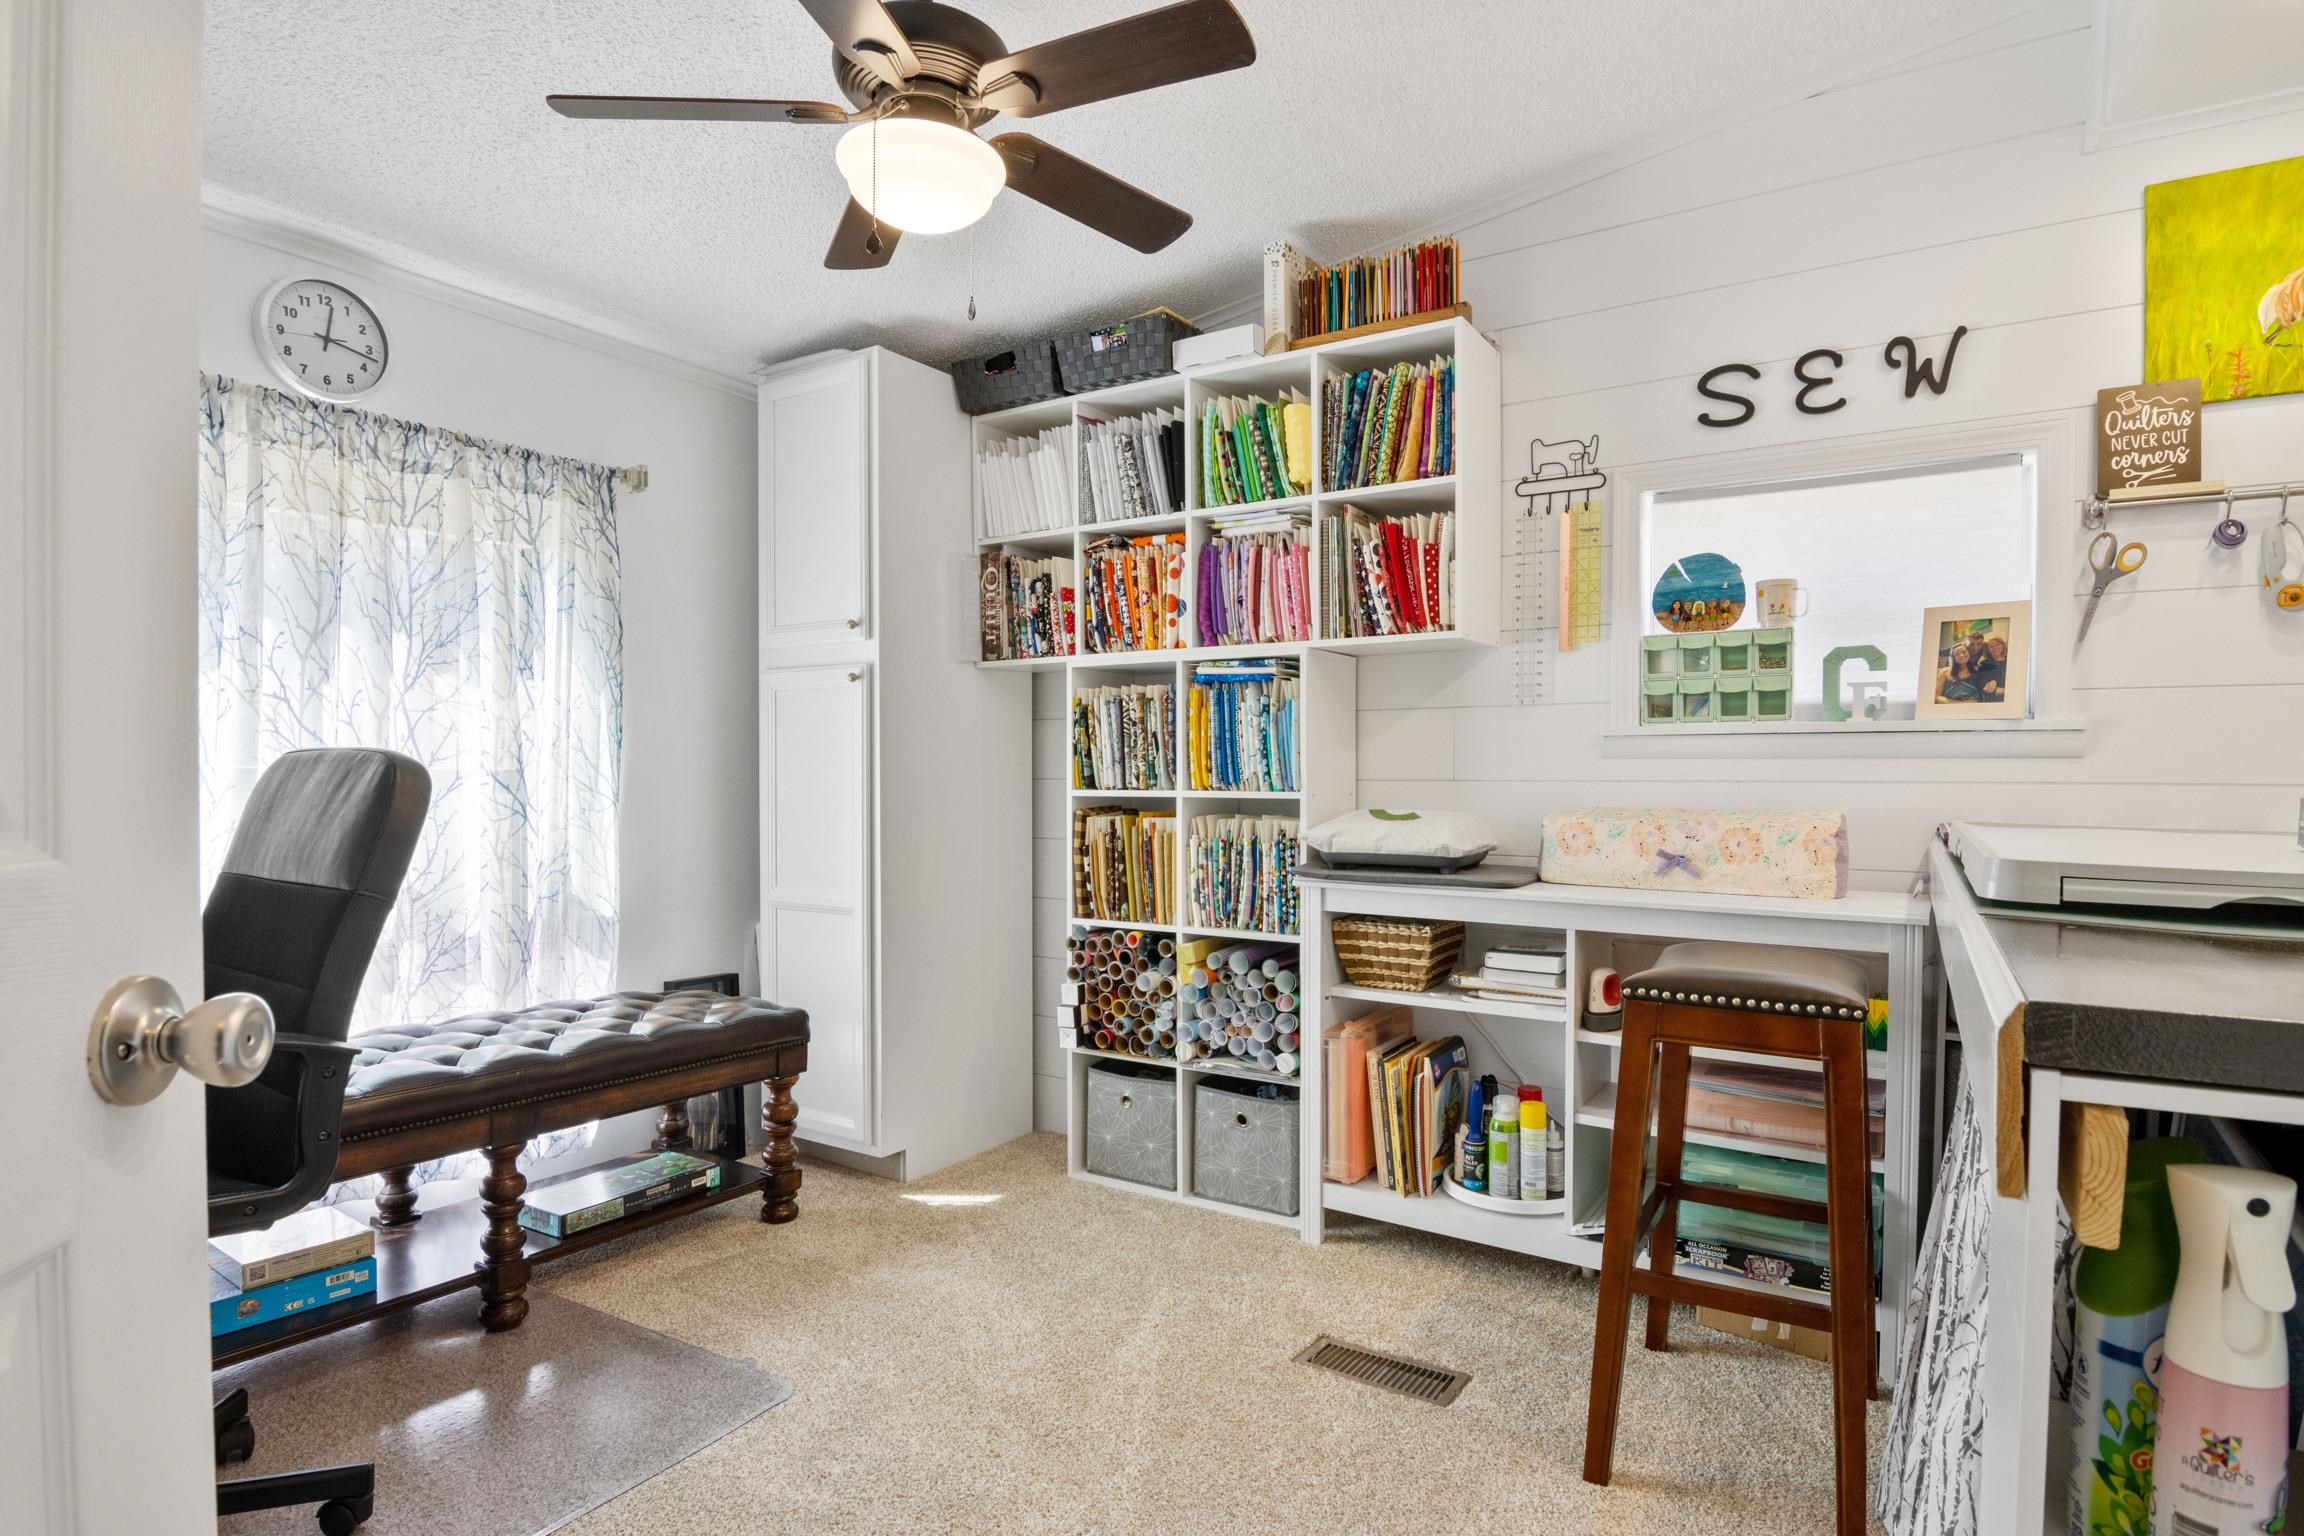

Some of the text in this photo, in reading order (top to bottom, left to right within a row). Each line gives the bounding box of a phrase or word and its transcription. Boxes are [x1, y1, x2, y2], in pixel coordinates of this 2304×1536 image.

[298, 295, 311, 307] 11
[317, 293, 333, 307] 12
[282, 305, 298, 319] 10
[343, 306, 351, 317] 1
[276, 324, 285, 335] 9
[358, 324, 367, 336] 2
[283, 345, 293, 356] 8
[365, 345, 374, 356] 3
[299, 363, 309, 375] 7
[359, 363, 369, 373] 4
[323, 375, 332, 386] 6
[346, 374, 355, 385] 5
[2105, 404, 2195, 436] Quilters
[2111, 428, 2189, 452] NEVER CUT
[2111, 446, 2190, 470] corners
[1699, 1243, 1728, 1253] OCCASION
